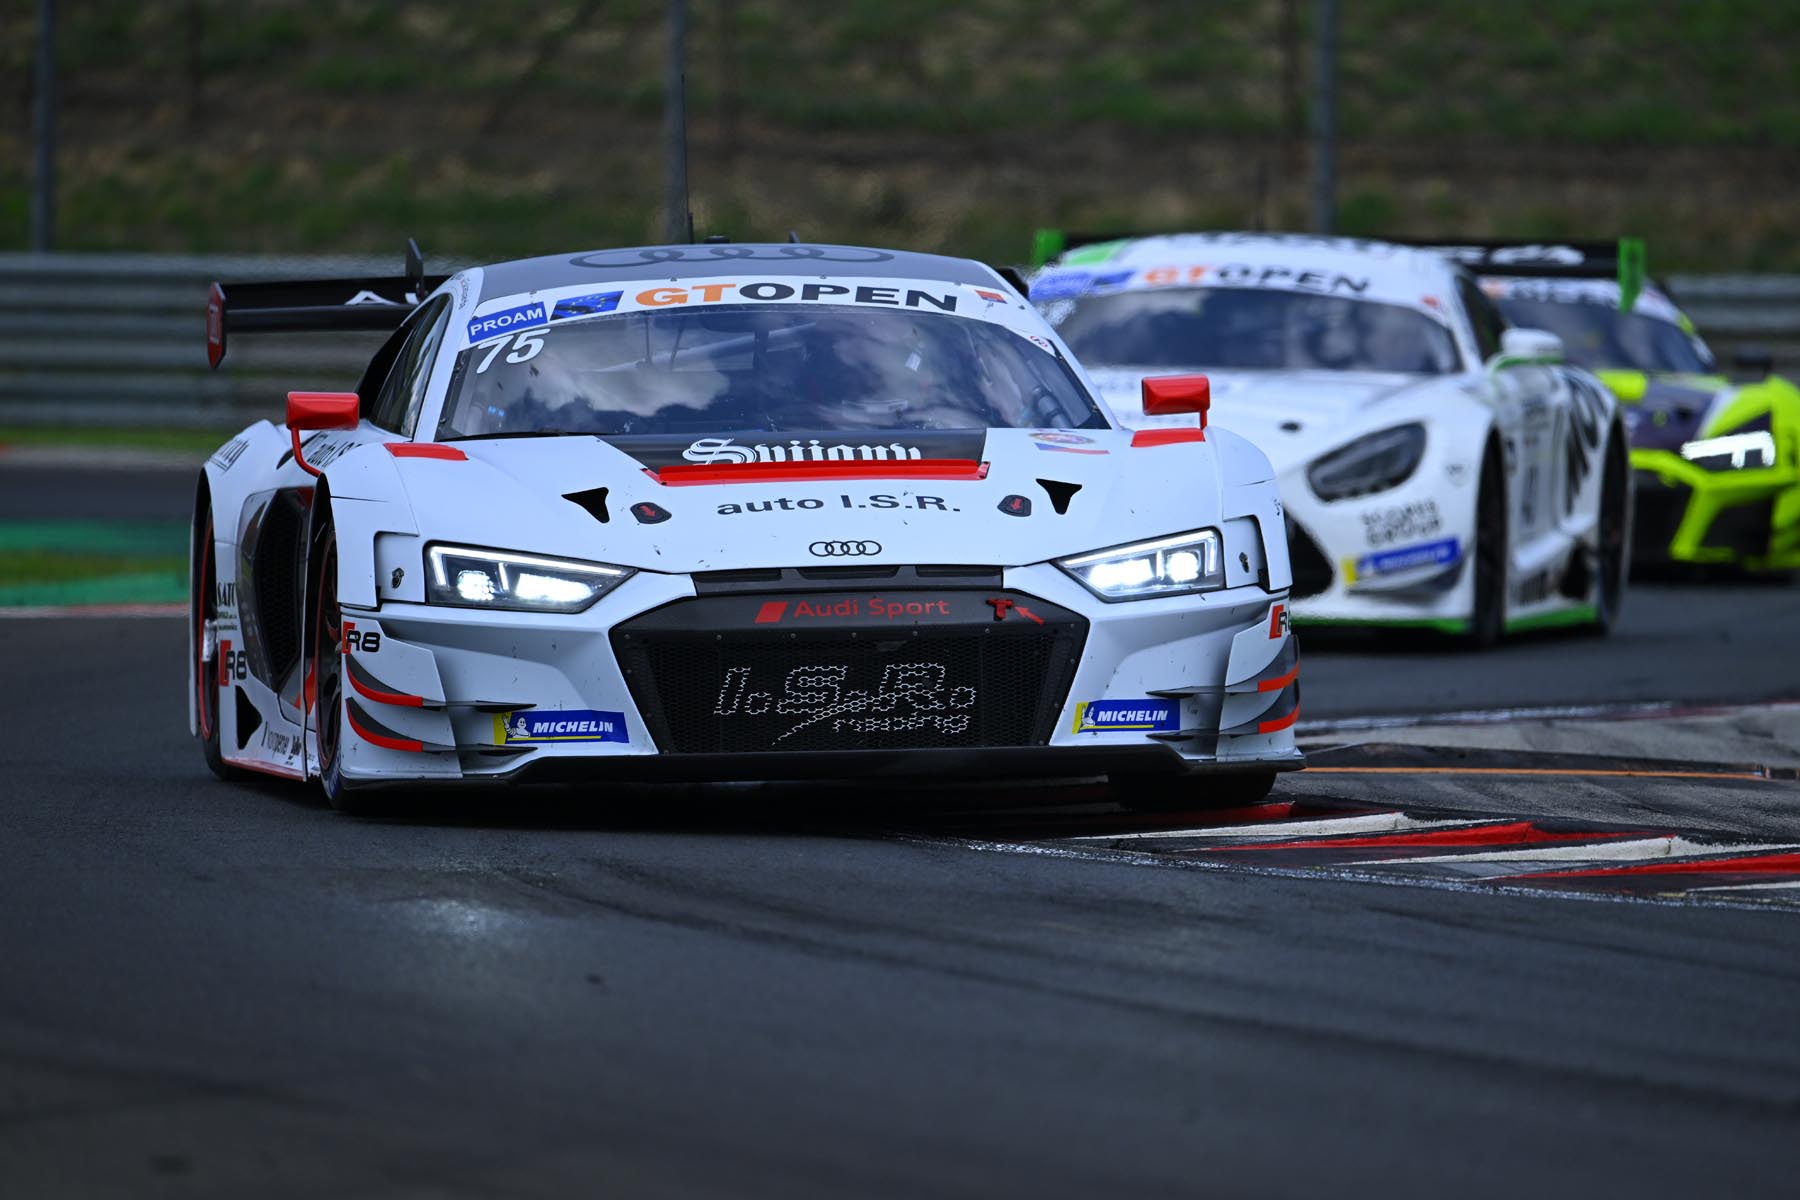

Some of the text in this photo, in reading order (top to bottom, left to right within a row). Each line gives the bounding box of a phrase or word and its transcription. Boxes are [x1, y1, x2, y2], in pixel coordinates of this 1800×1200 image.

[470, 307, 544, 336] PROAM
[476, 329, 550, 374] 75
[717, 494, 961, 515] auto I.S.R.
[793, 599, 951, 619] Audi Sport
[346, 630, 381, 653] R8
[224, 650, 248, 681] R8
[532, 721, 614, 734] MICHELIN
[1096, 710, 1169, 723] MICHELIN
